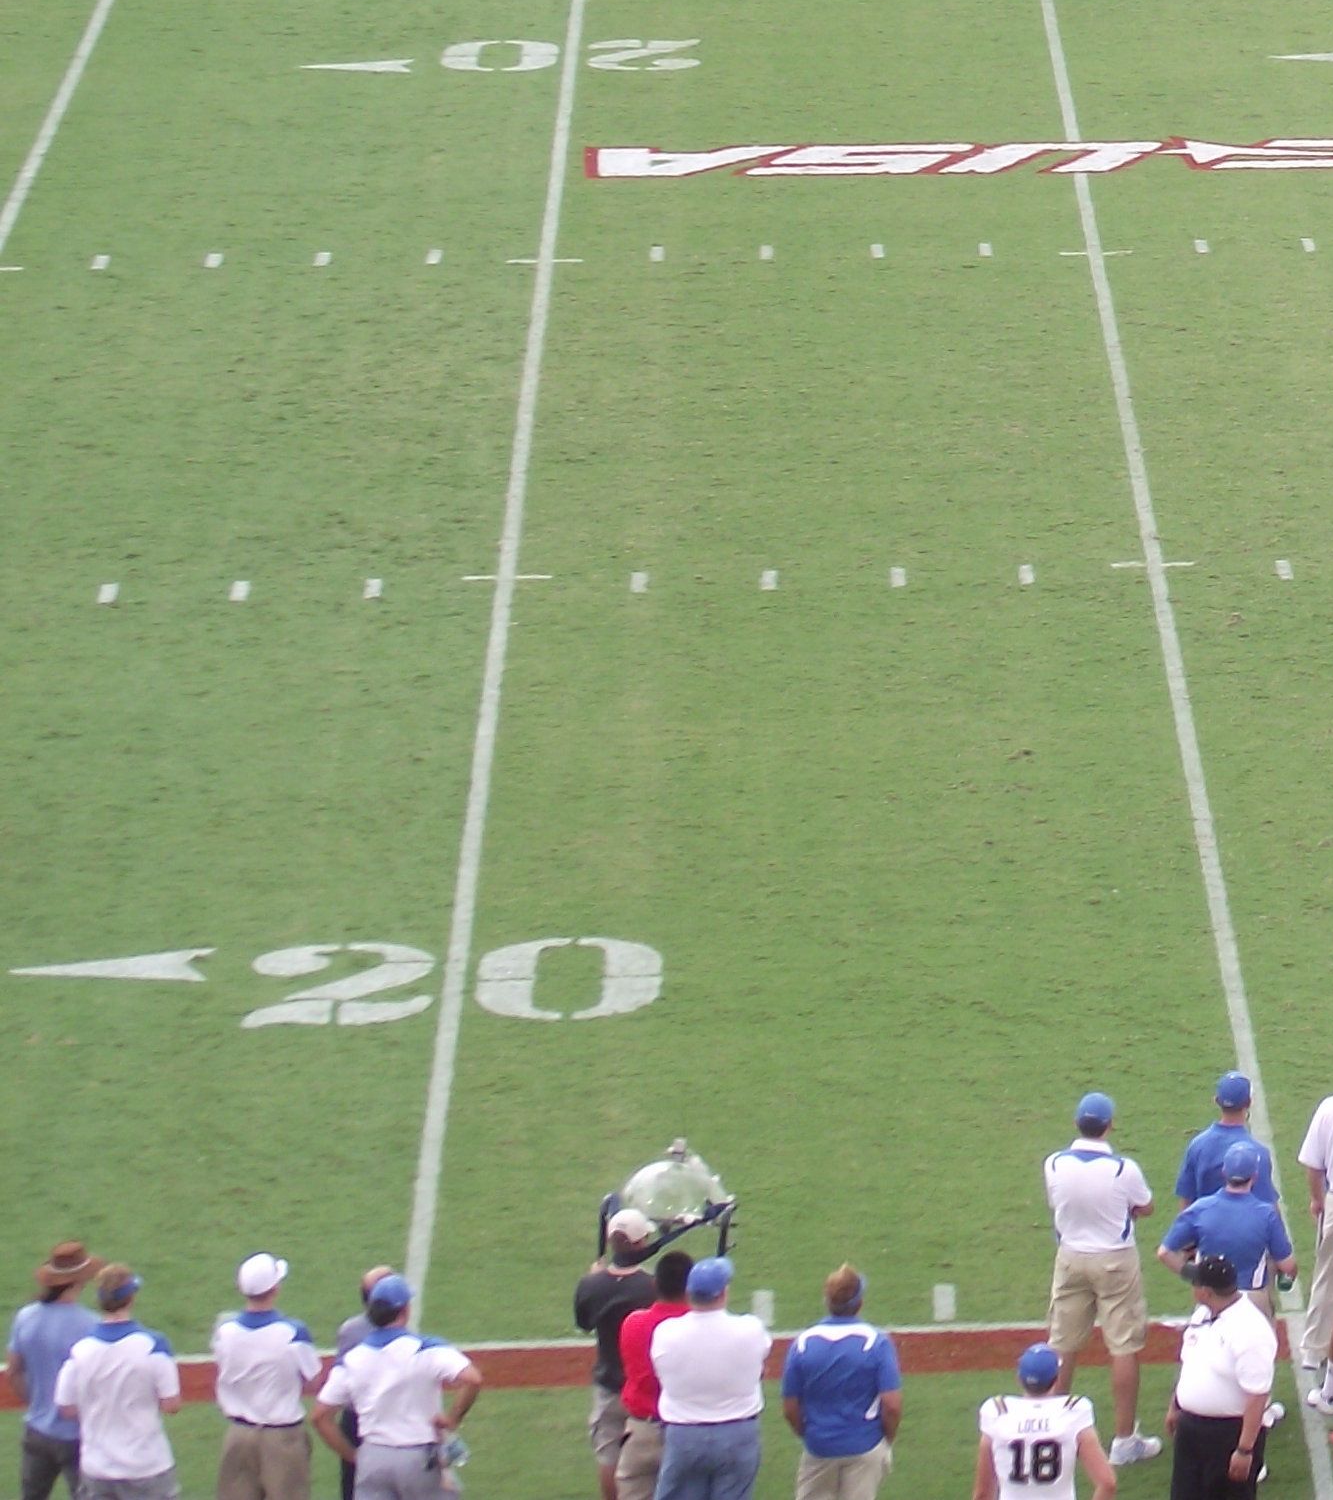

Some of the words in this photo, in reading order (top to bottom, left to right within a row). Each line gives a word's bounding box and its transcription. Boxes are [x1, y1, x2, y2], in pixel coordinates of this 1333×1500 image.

[441, 39, 701, 71] 20
[241, 936, 664, 1028] 20
[1017, 1418, 1051, 1434] LOCKE
[1006, 1438, 1063, 1485] 18
